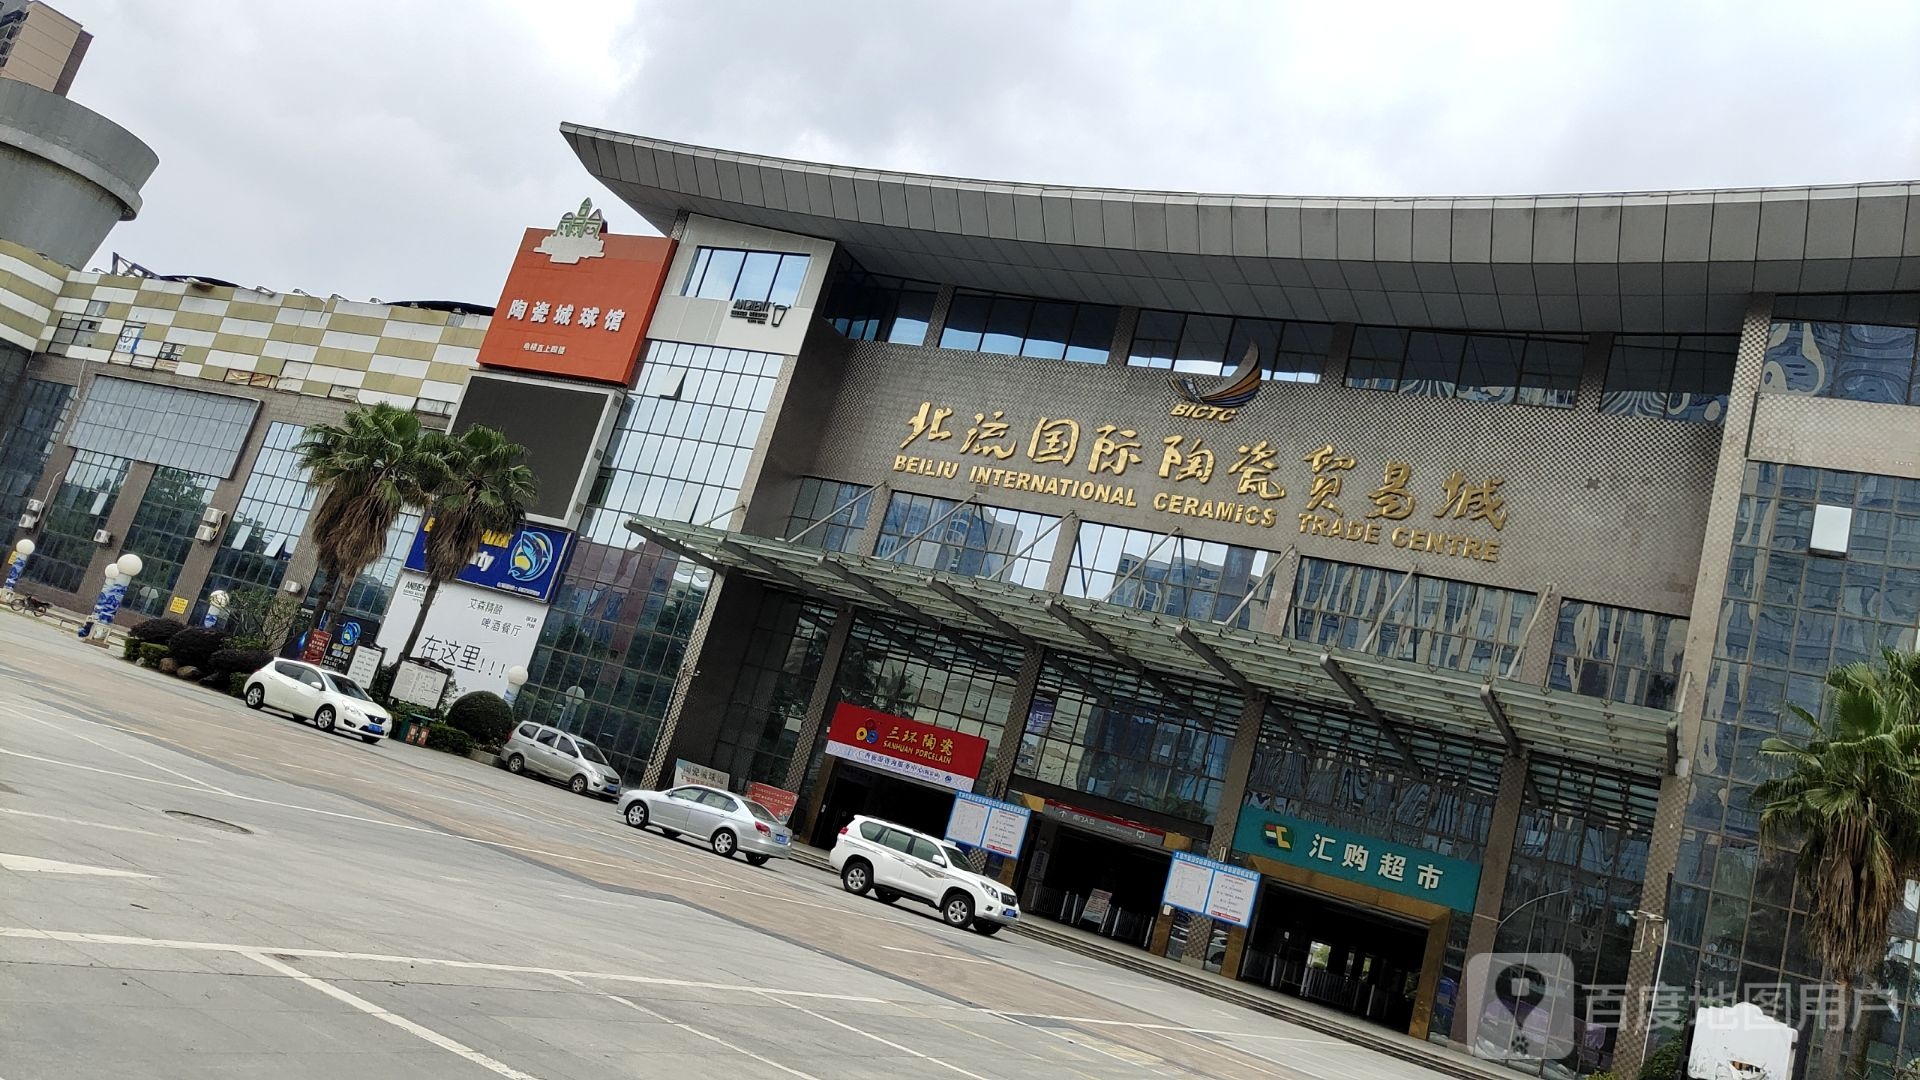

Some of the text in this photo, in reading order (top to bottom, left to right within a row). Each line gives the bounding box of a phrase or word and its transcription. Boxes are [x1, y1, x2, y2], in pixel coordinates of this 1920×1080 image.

[507, 299, 626, 331] 陶瓷城球馆
[1170, 404, 1236, 422] BICTC
[899, 401, 1508, 531] 北流国际陶瓷贸易城
[893, 455, 960, 480] BEILIU
[968, 465, 1139, 508] INTERNATIONAL
[1299, 513, 1382, 545] TRADE
[1391, 526, 1500, 563] CENTRE
[481, 617, 523, 637] 啤酒餐厅
[883, 740, 952, 765] SANHUAN PORCELAIN
[886, 726, 954, 756] 三环陶瓷
[1308, 833, 1444, 890] 汇购超市
